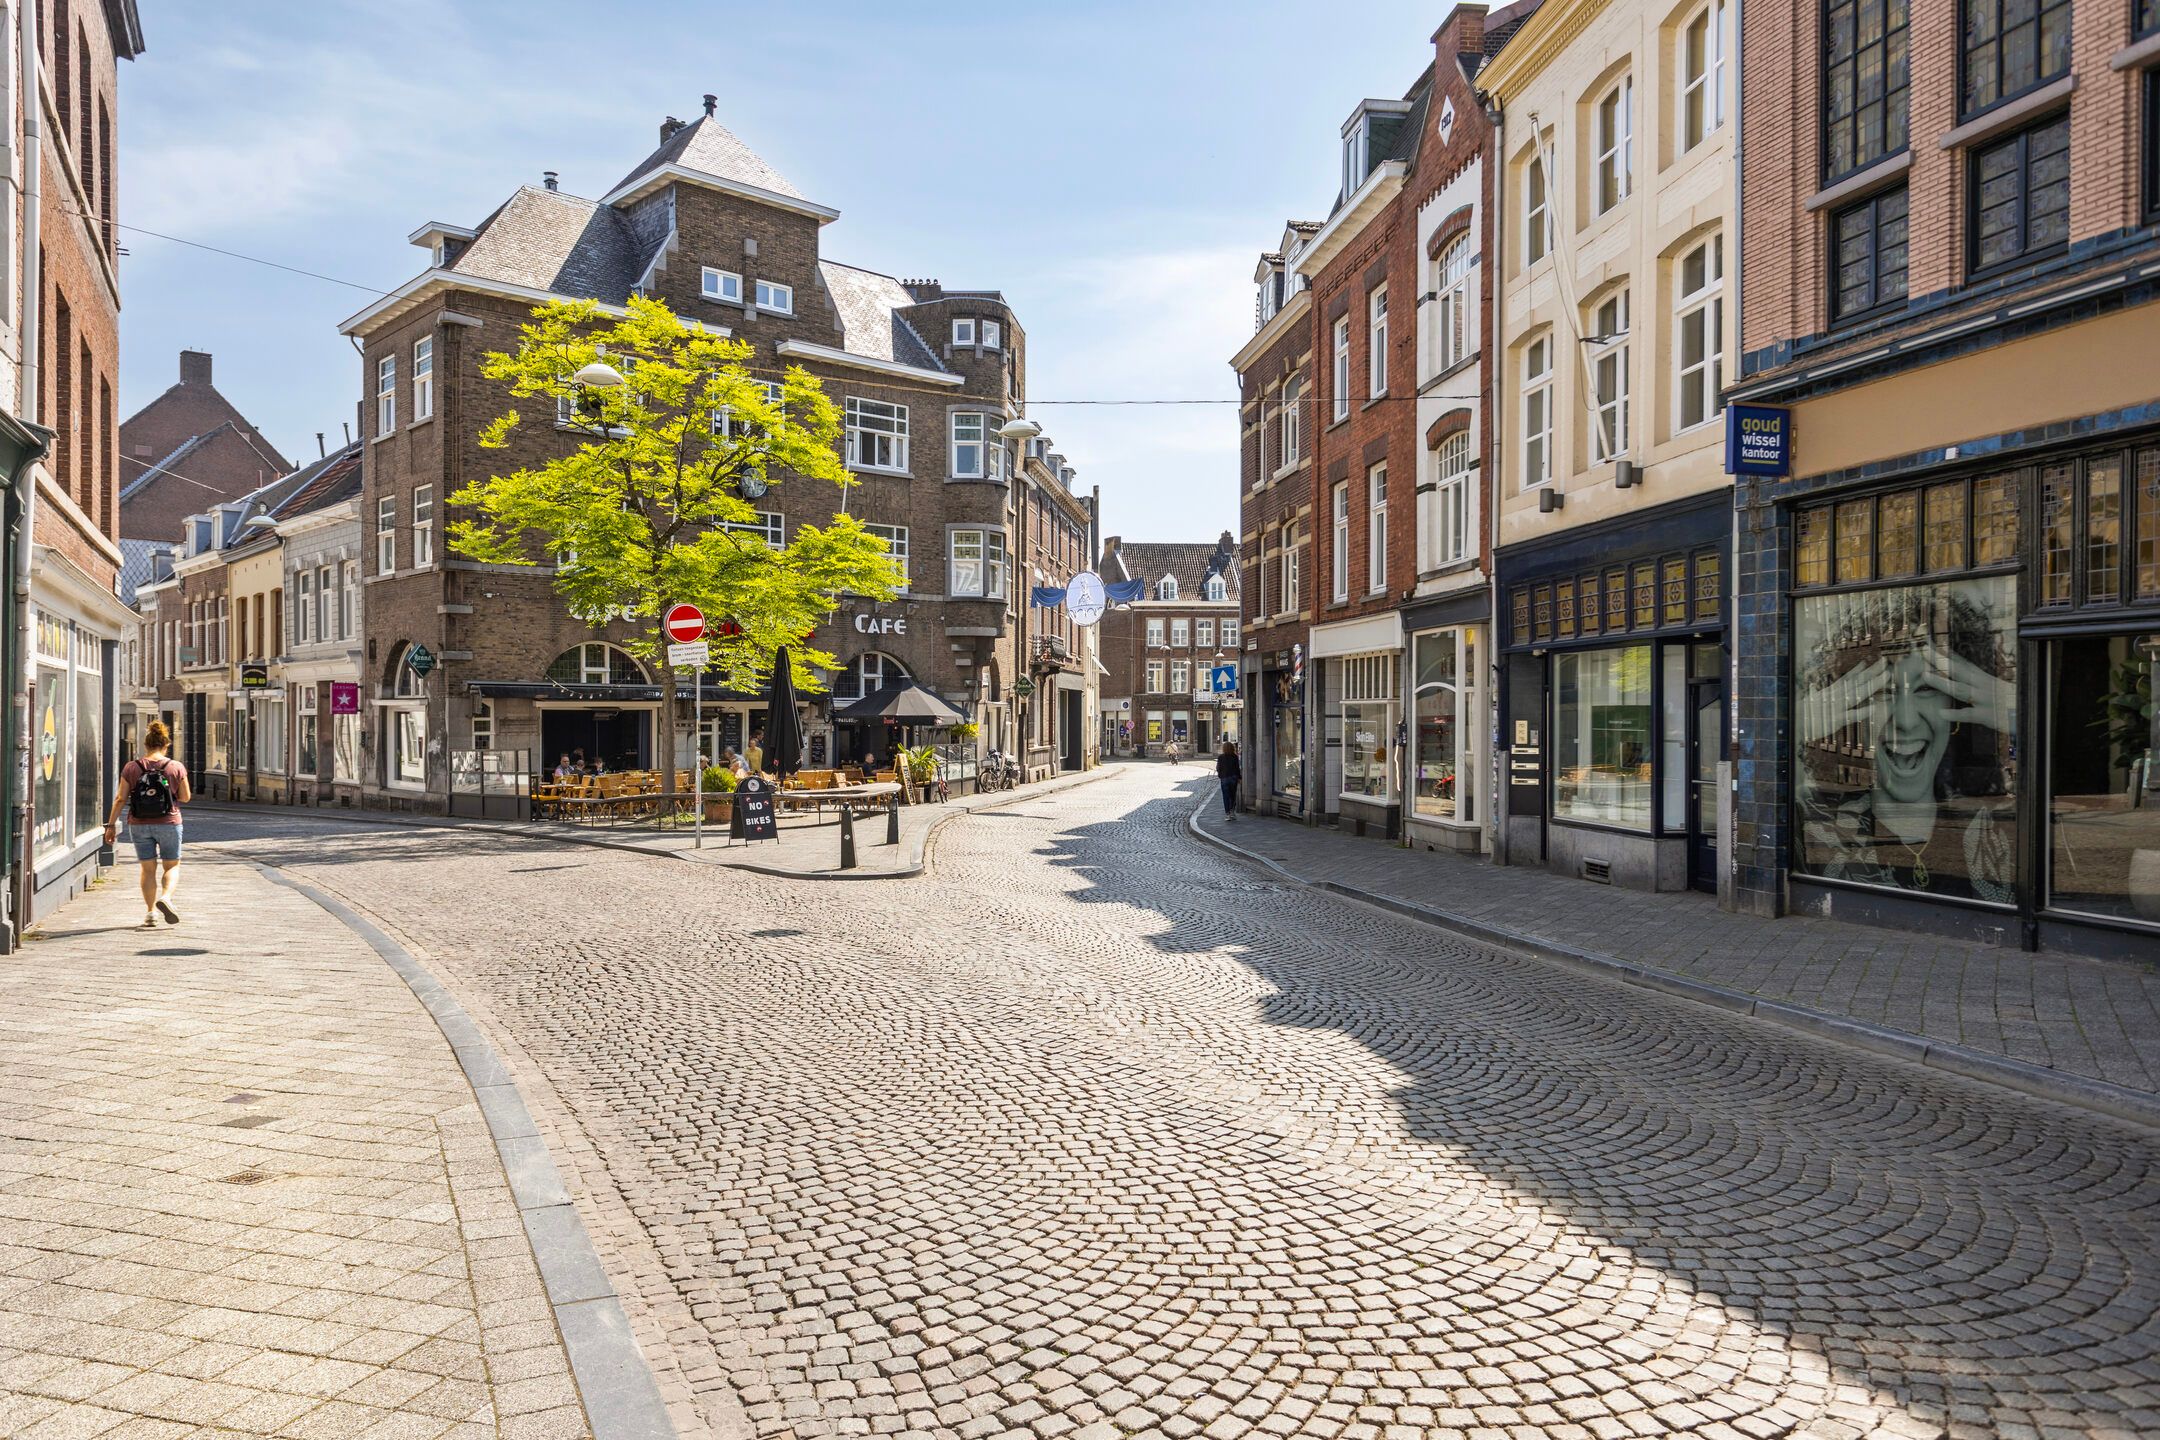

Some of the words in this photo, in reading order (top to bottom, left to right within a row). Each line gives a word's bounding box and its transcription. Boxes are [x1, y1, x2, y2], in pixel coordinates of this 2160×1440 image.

[1742, 417, 1780, 434] goud
[1742, 433, 1780, 447] wissel
[1742, 446, 1780, 459] kantoor
[855, 614, 907, 635] CAFÉ
[749, 802, 763, 811] NO
[745, 816, 772, 826] BIKES
